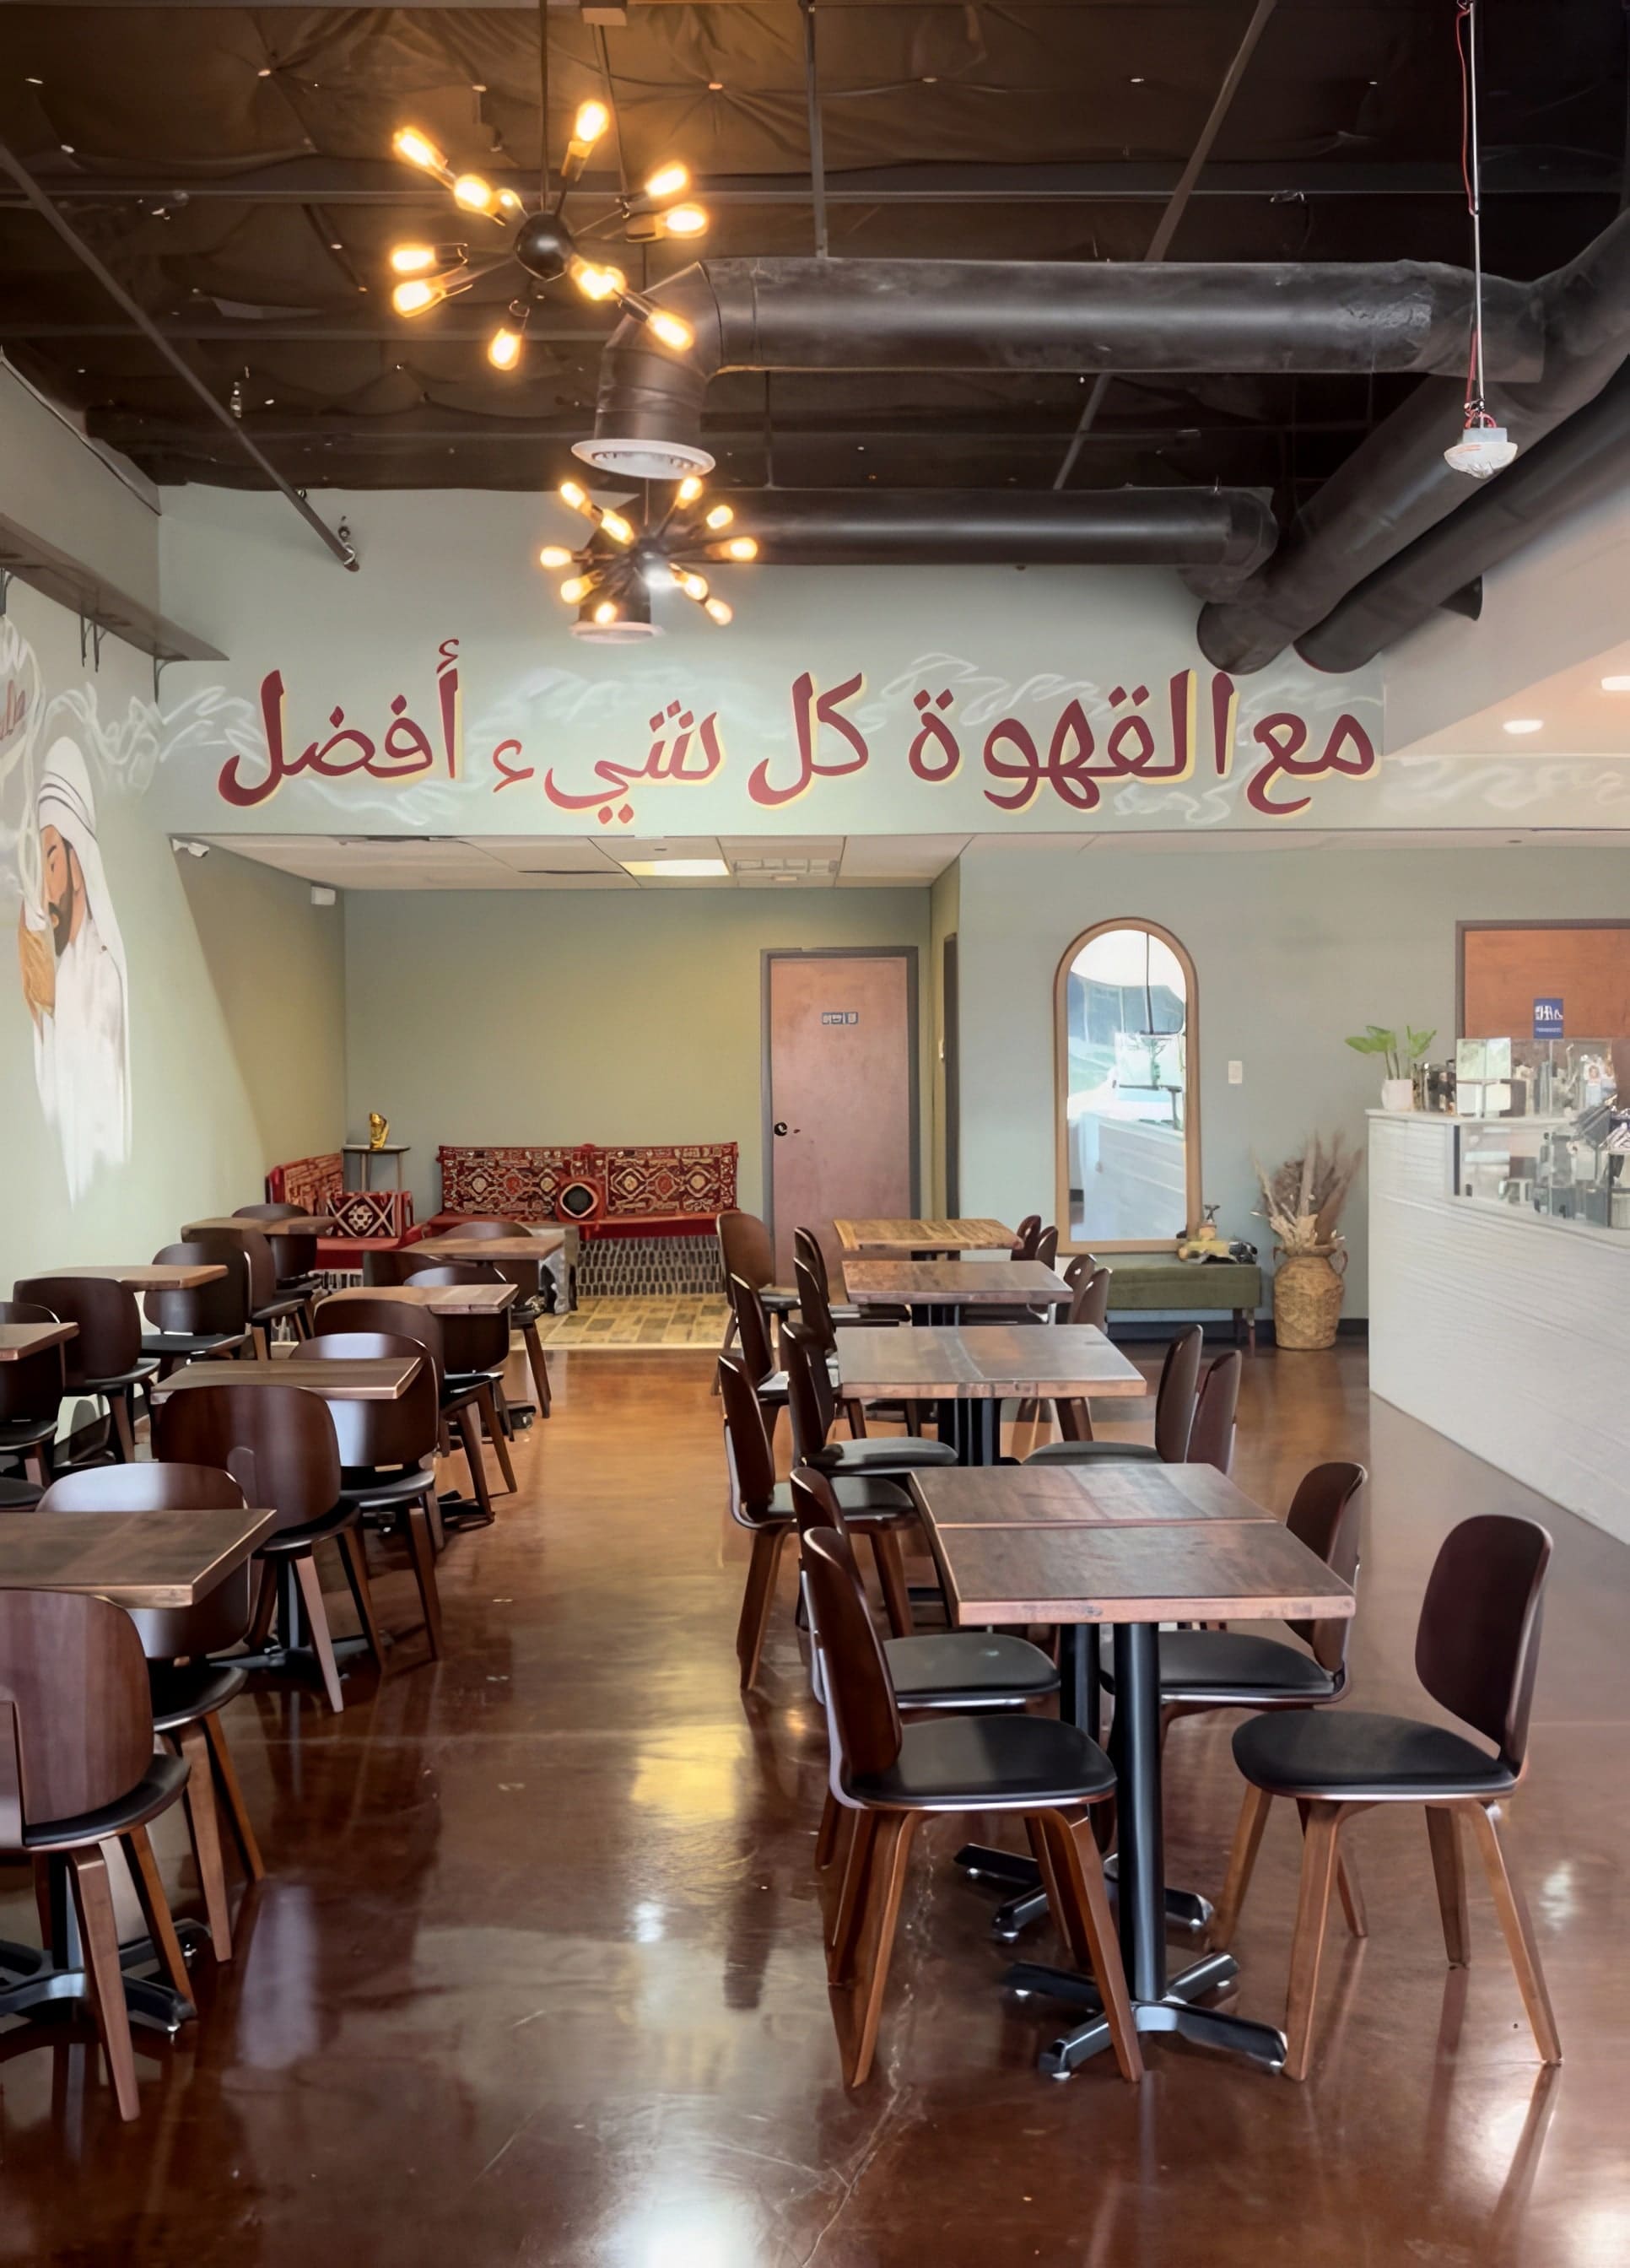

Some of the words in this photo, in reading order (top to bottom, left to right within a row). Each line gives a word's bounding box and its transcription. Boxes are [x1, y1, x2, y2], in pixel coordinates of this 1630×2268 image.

[218, 639, 460, 807] أفضل
[492, 699, 721, 824] شيء
[748, 672, 870, 807] كل
[908, 669, 1234, 811] القهوة
[1245, 711, 1375, 816] مع
